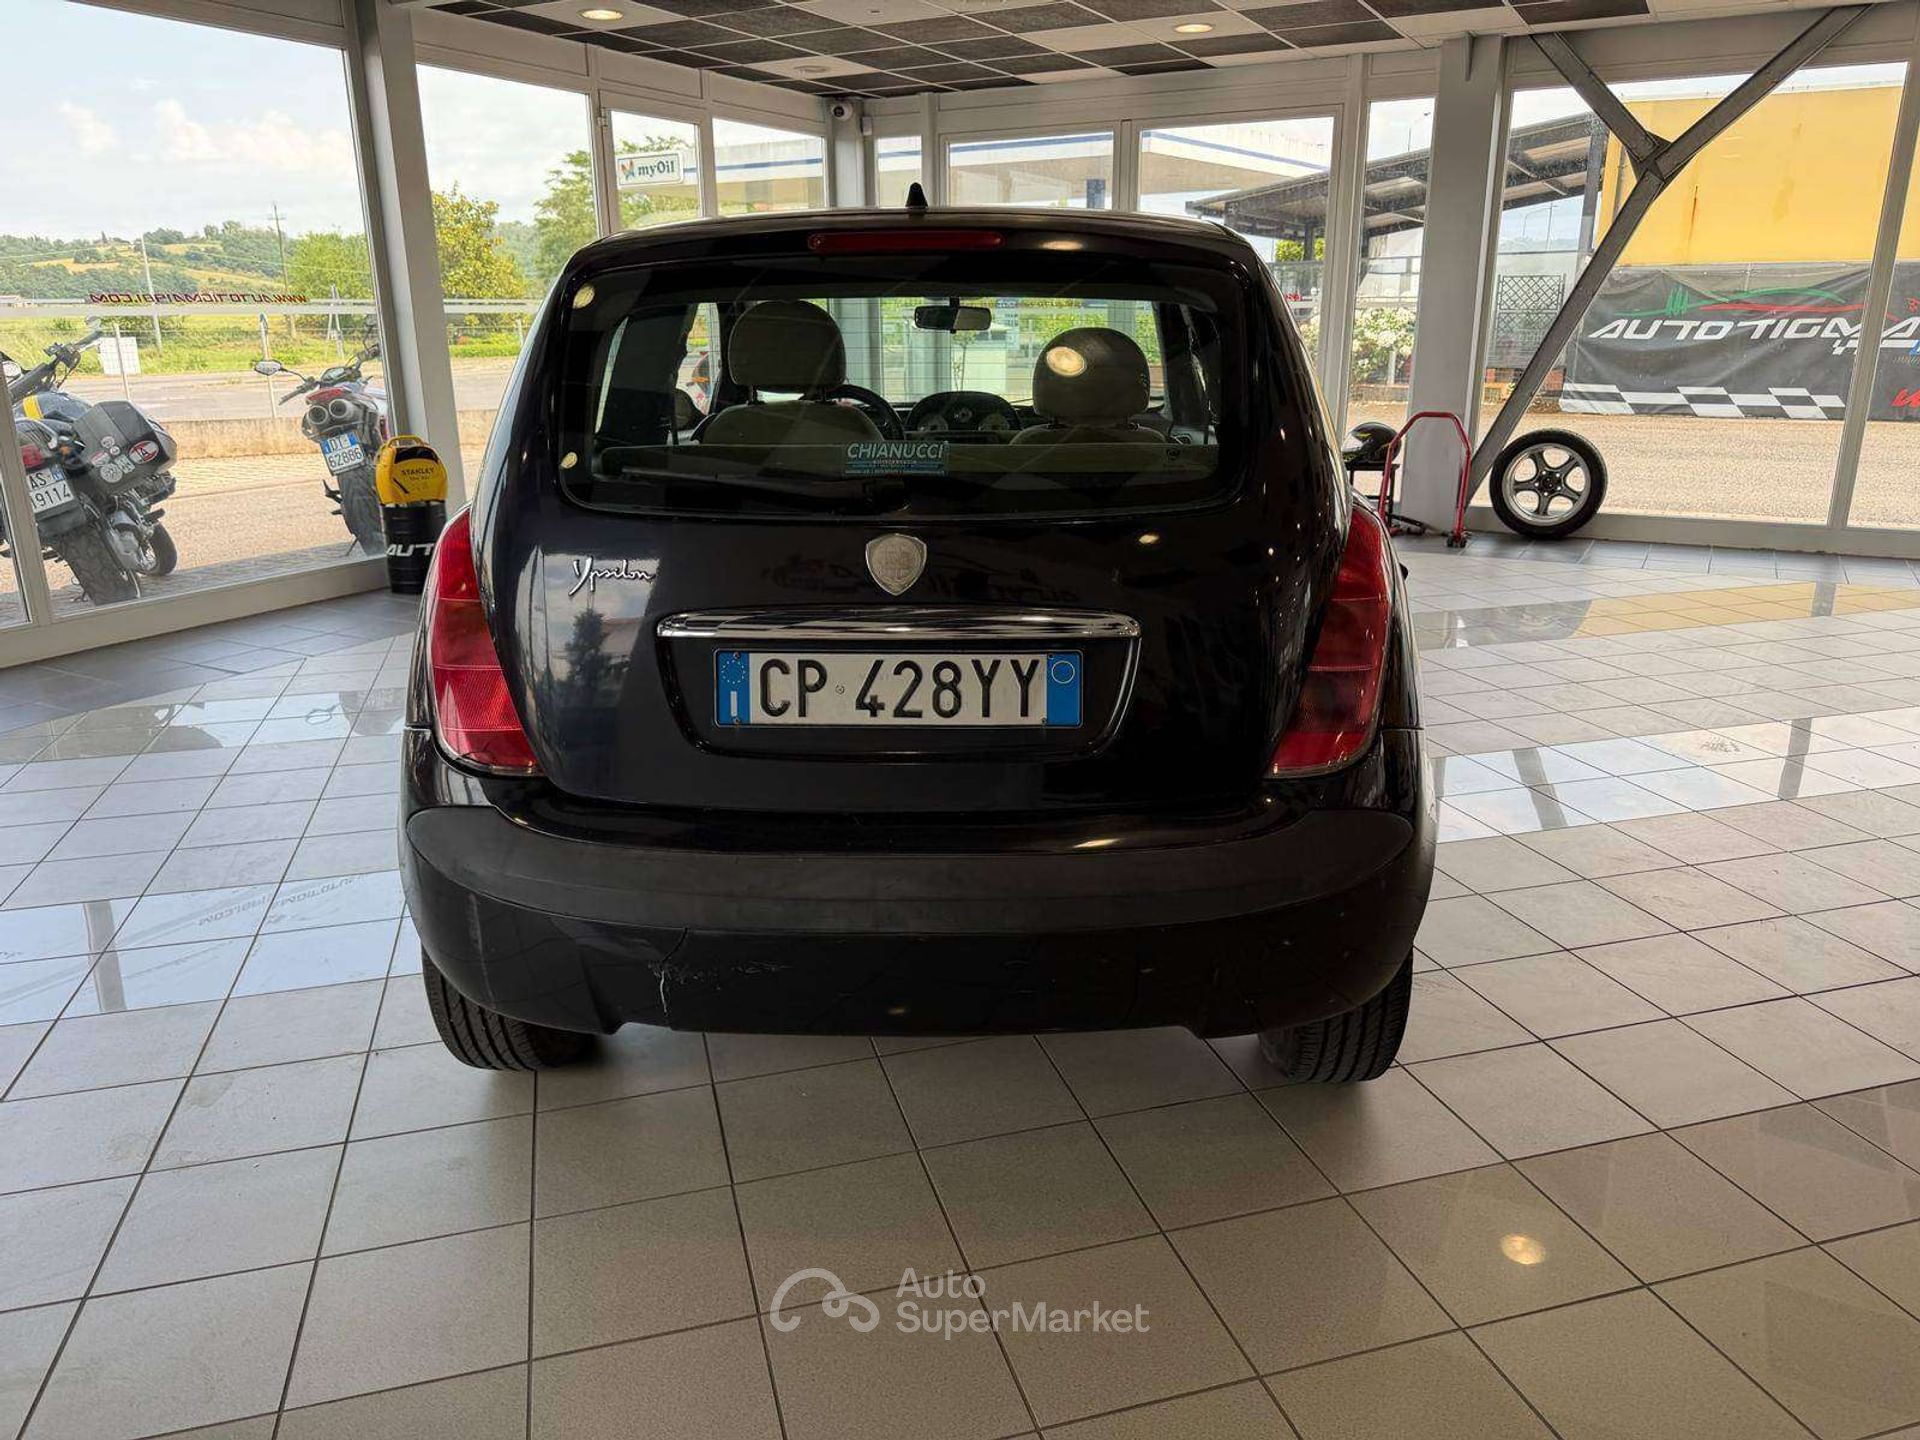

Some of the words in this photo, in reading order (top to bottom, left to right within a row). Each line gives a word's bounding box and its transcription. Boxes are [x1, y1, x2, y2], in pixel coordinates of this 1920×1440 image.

[638, 160, 675, 177] myOil
[847, 443, 944, 459] CHIANUCCI
[29, 472, 47, 490] AS
[568, 557, 656, 596] Ypsilon
[759, 659, 827, 718] CP
[855, 659, 1040, 718] 428YY
